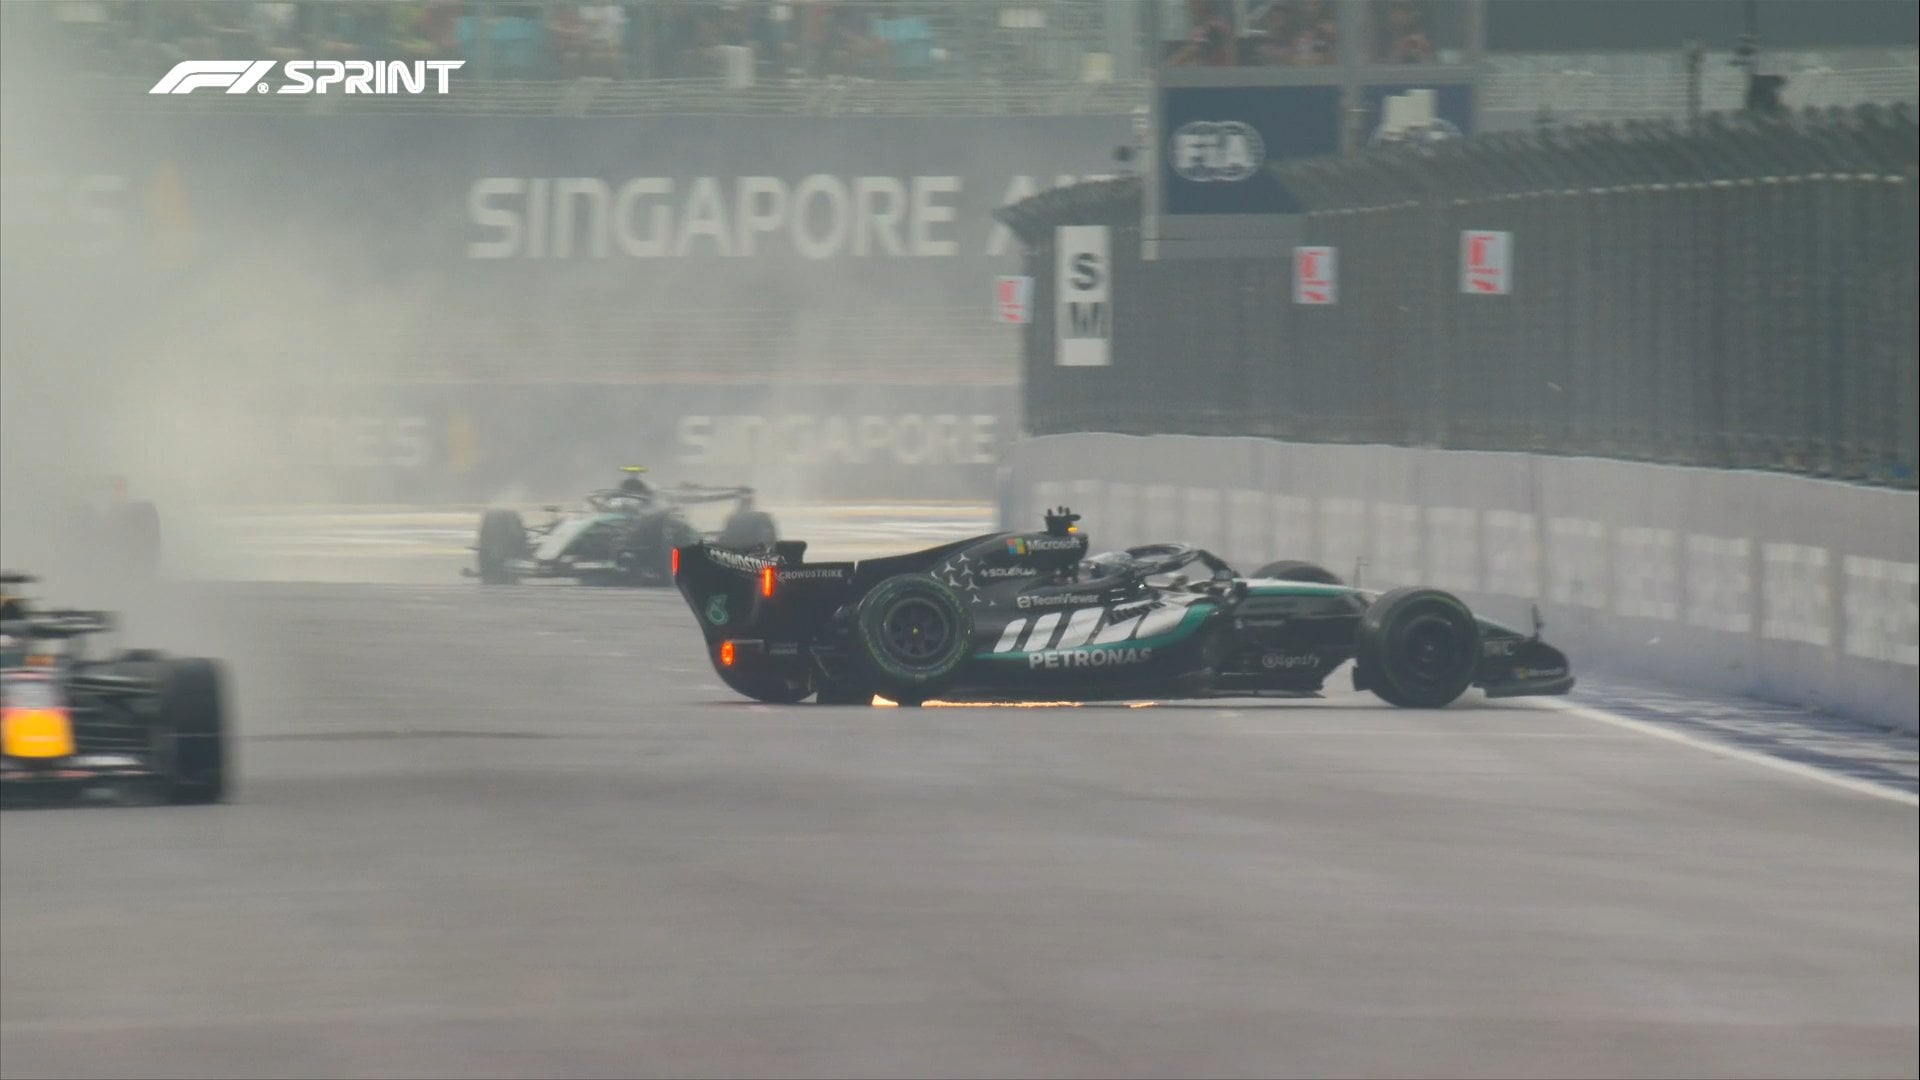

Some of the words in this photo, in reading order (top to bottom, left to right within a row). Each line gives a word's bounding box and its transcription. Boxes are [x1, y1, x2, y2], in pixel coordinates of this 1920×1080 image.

[467, 176, 957, 258] SINGAPORE
[678, 414, 998, 465] SINGAPORE
[1027, 538, 1081, 550] Microsoft
[779, 568, 843, 580] CROWDSTRIKE
[1031, 593, 1099, 607] TeamViewer
[1029, 646, 1152, 669] PETRONAS
